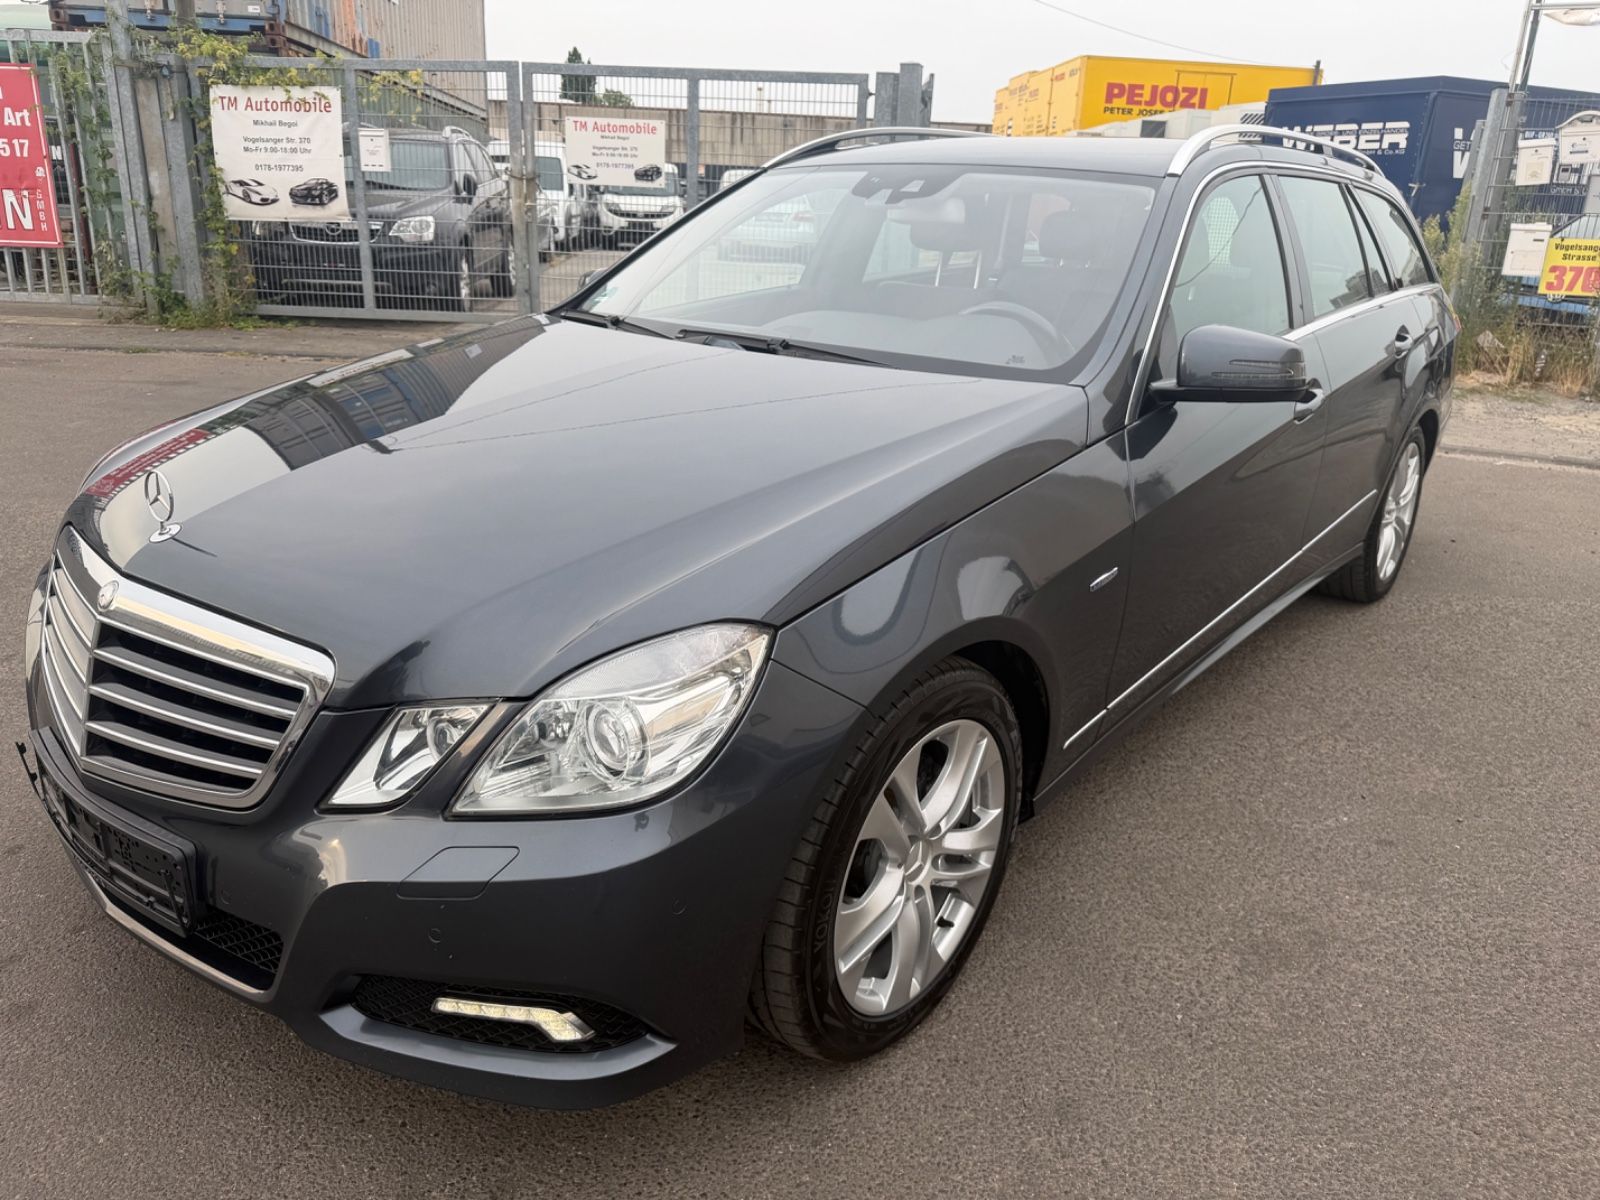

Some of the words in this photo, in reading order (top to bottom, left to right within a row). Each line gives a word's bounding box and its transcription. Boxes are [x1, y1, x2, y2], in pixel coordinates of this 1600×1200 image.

[1104, 82, 1208, 109] PEJOZI
[219, 96, 238, 111] TM
[245, 97, 332, 113] Automobile
[1103, 106, 1134, 115] PETER
[4, 107, 31, 127] Art
[573, 121, 588, 131] TM
[592, 121, 657, 135] Automobile
[1554, 243, 1600, 253] Vogelsang
[1561, 253, 1597, 262] Strasse
[1545, 265, 1600, 292] 370
